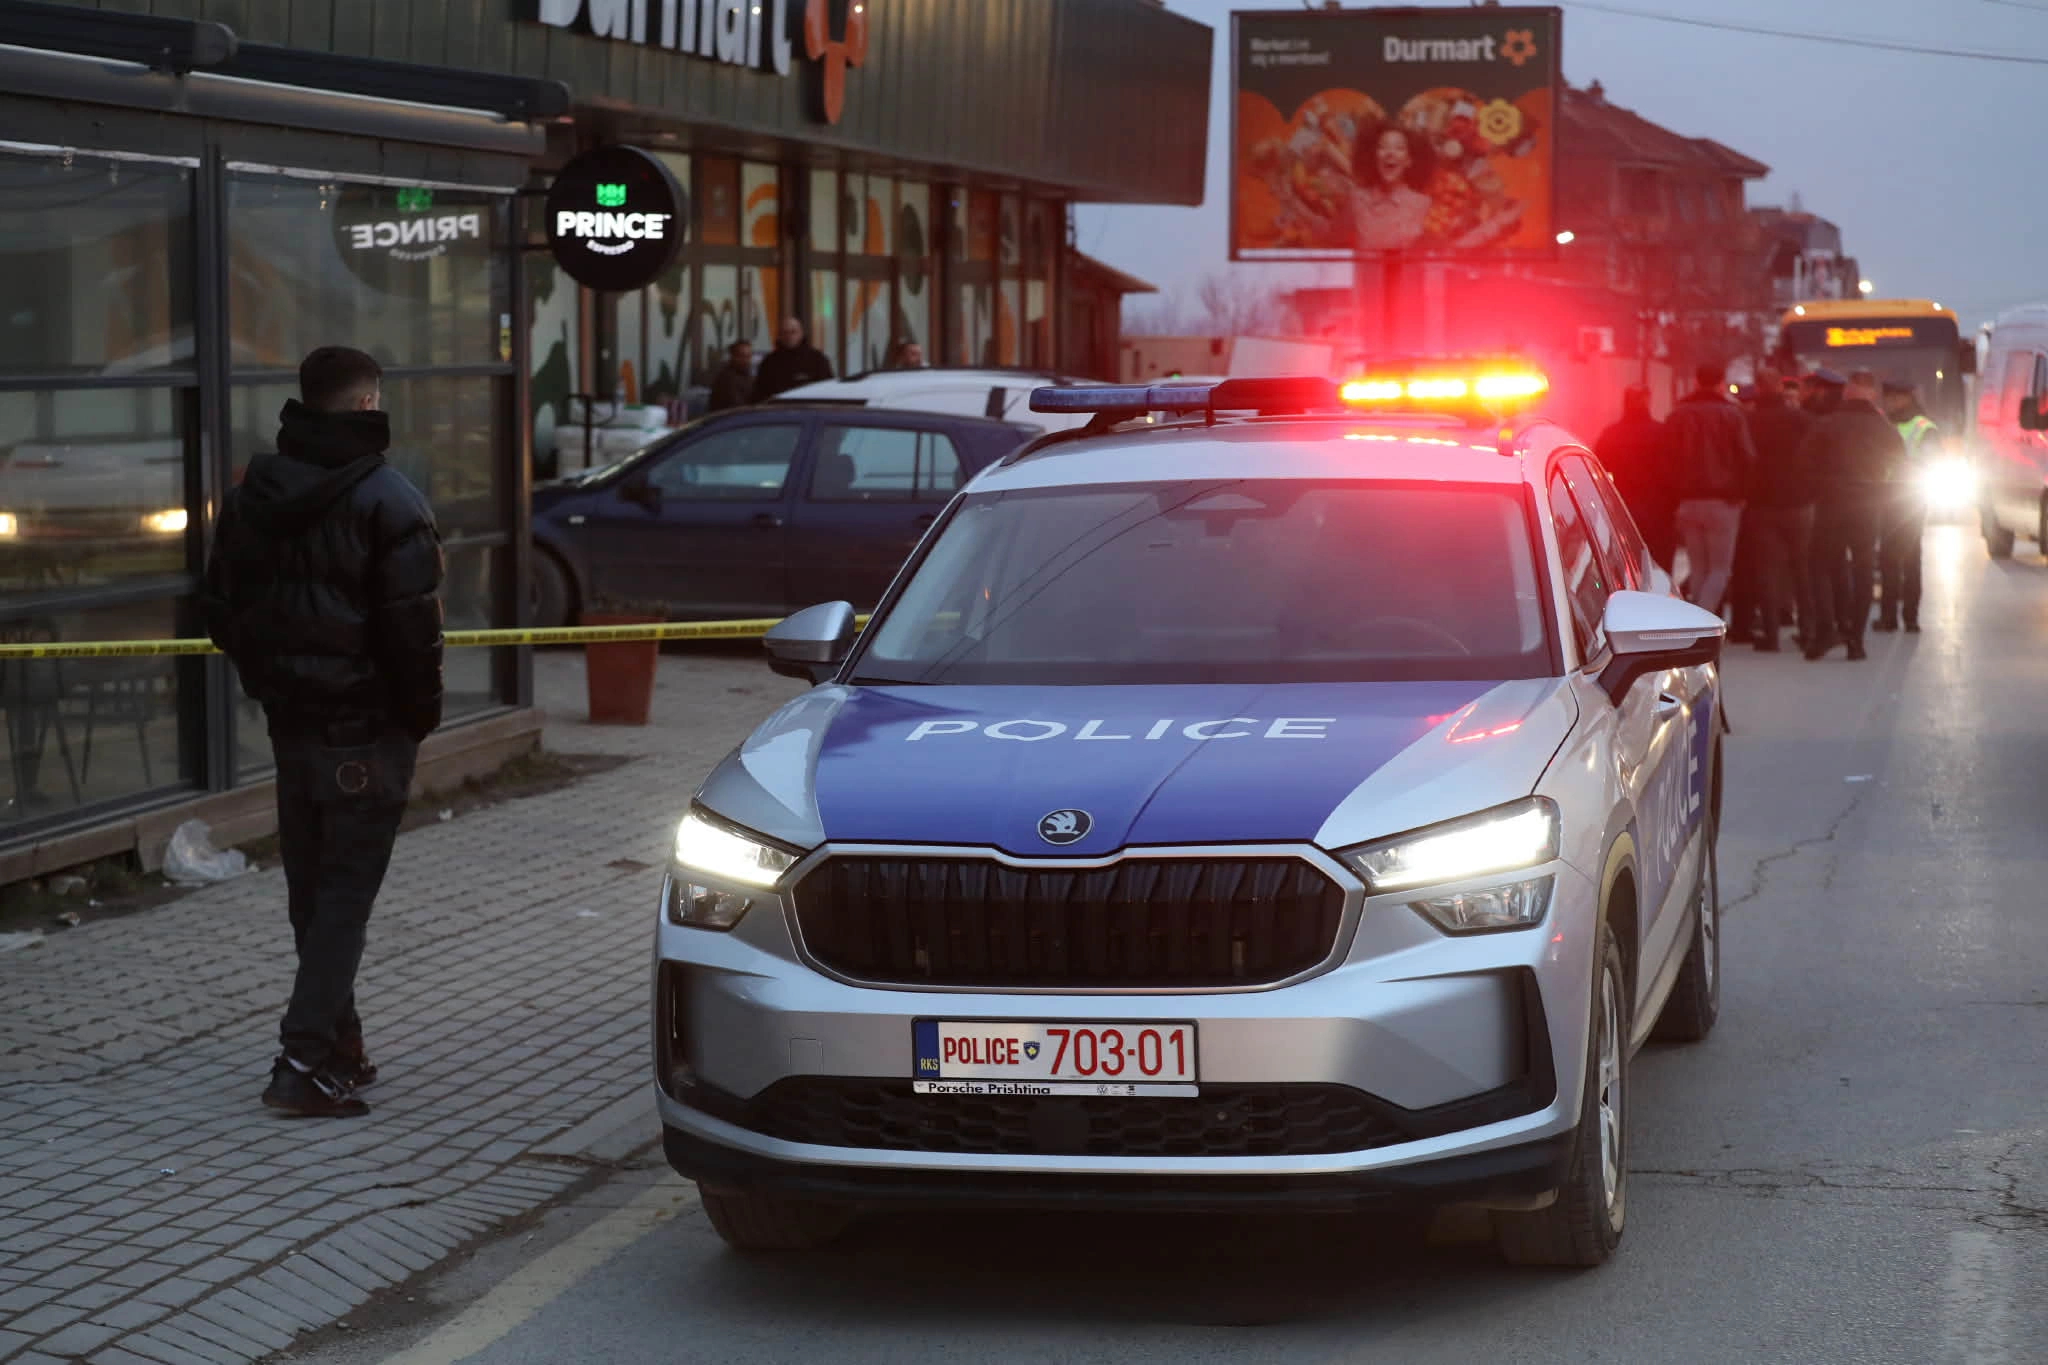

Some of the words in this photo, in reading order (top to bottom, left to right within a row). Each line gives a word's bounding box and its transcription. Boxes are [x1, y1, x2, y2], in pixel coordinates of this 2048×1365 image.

[1384, 35, 1496, 61] Durmart
[556, 211, 664, 239] PRINCE
[905, 717, 1337, 742] POLICE
[920, 1057, 939, 1071] RKS
[943, 1037, 1020, 1065] POLICE
[1046, 1028, 1185, 1076] 703-01
[927, 1082, 984, 1093] Porsche
[988, 1084, 1051, 1094] Prishtina
